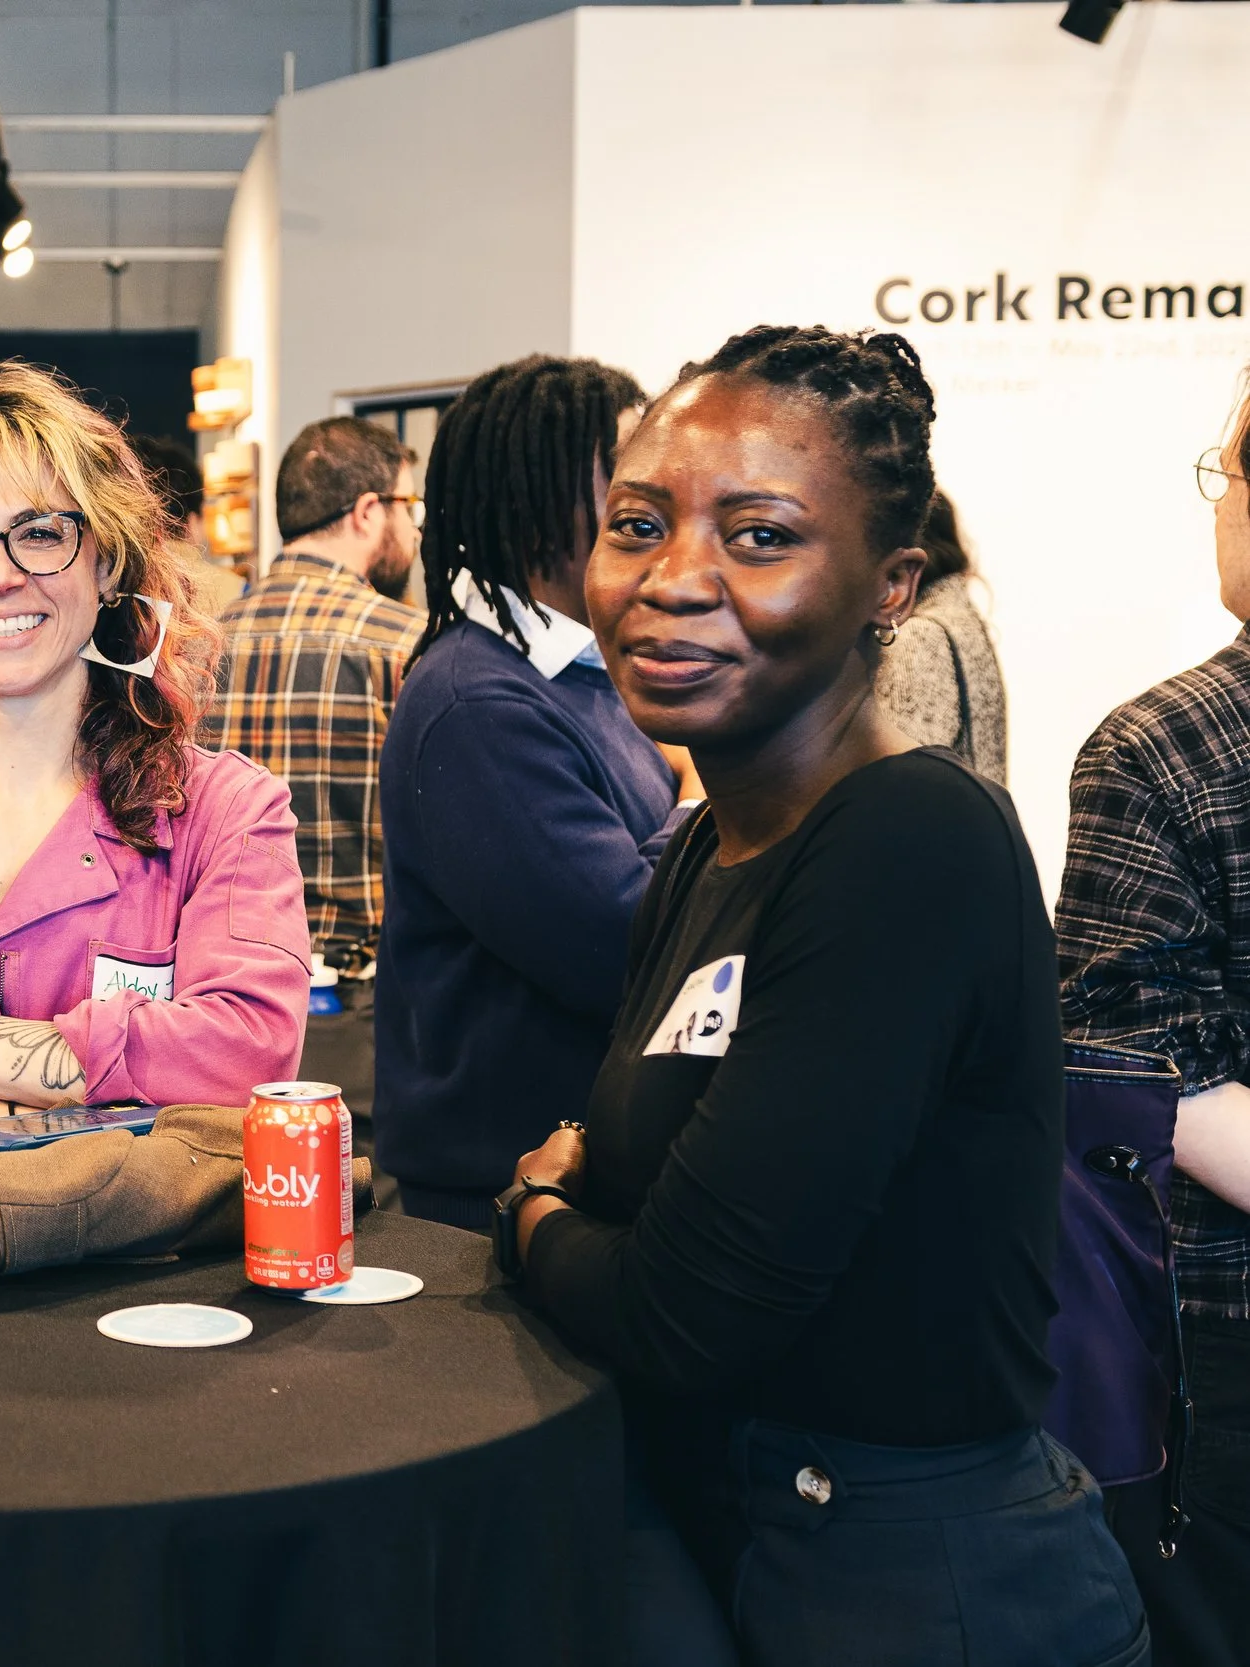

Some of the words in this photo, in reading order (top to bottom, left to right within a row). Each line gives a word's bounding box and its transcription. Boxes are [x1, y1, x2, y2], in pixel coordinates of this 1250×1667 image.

[875, 272, 1031, 324] Cork
[1057, 275, 1244, 320] Rema
[271, 1198, 301, 1208] water
